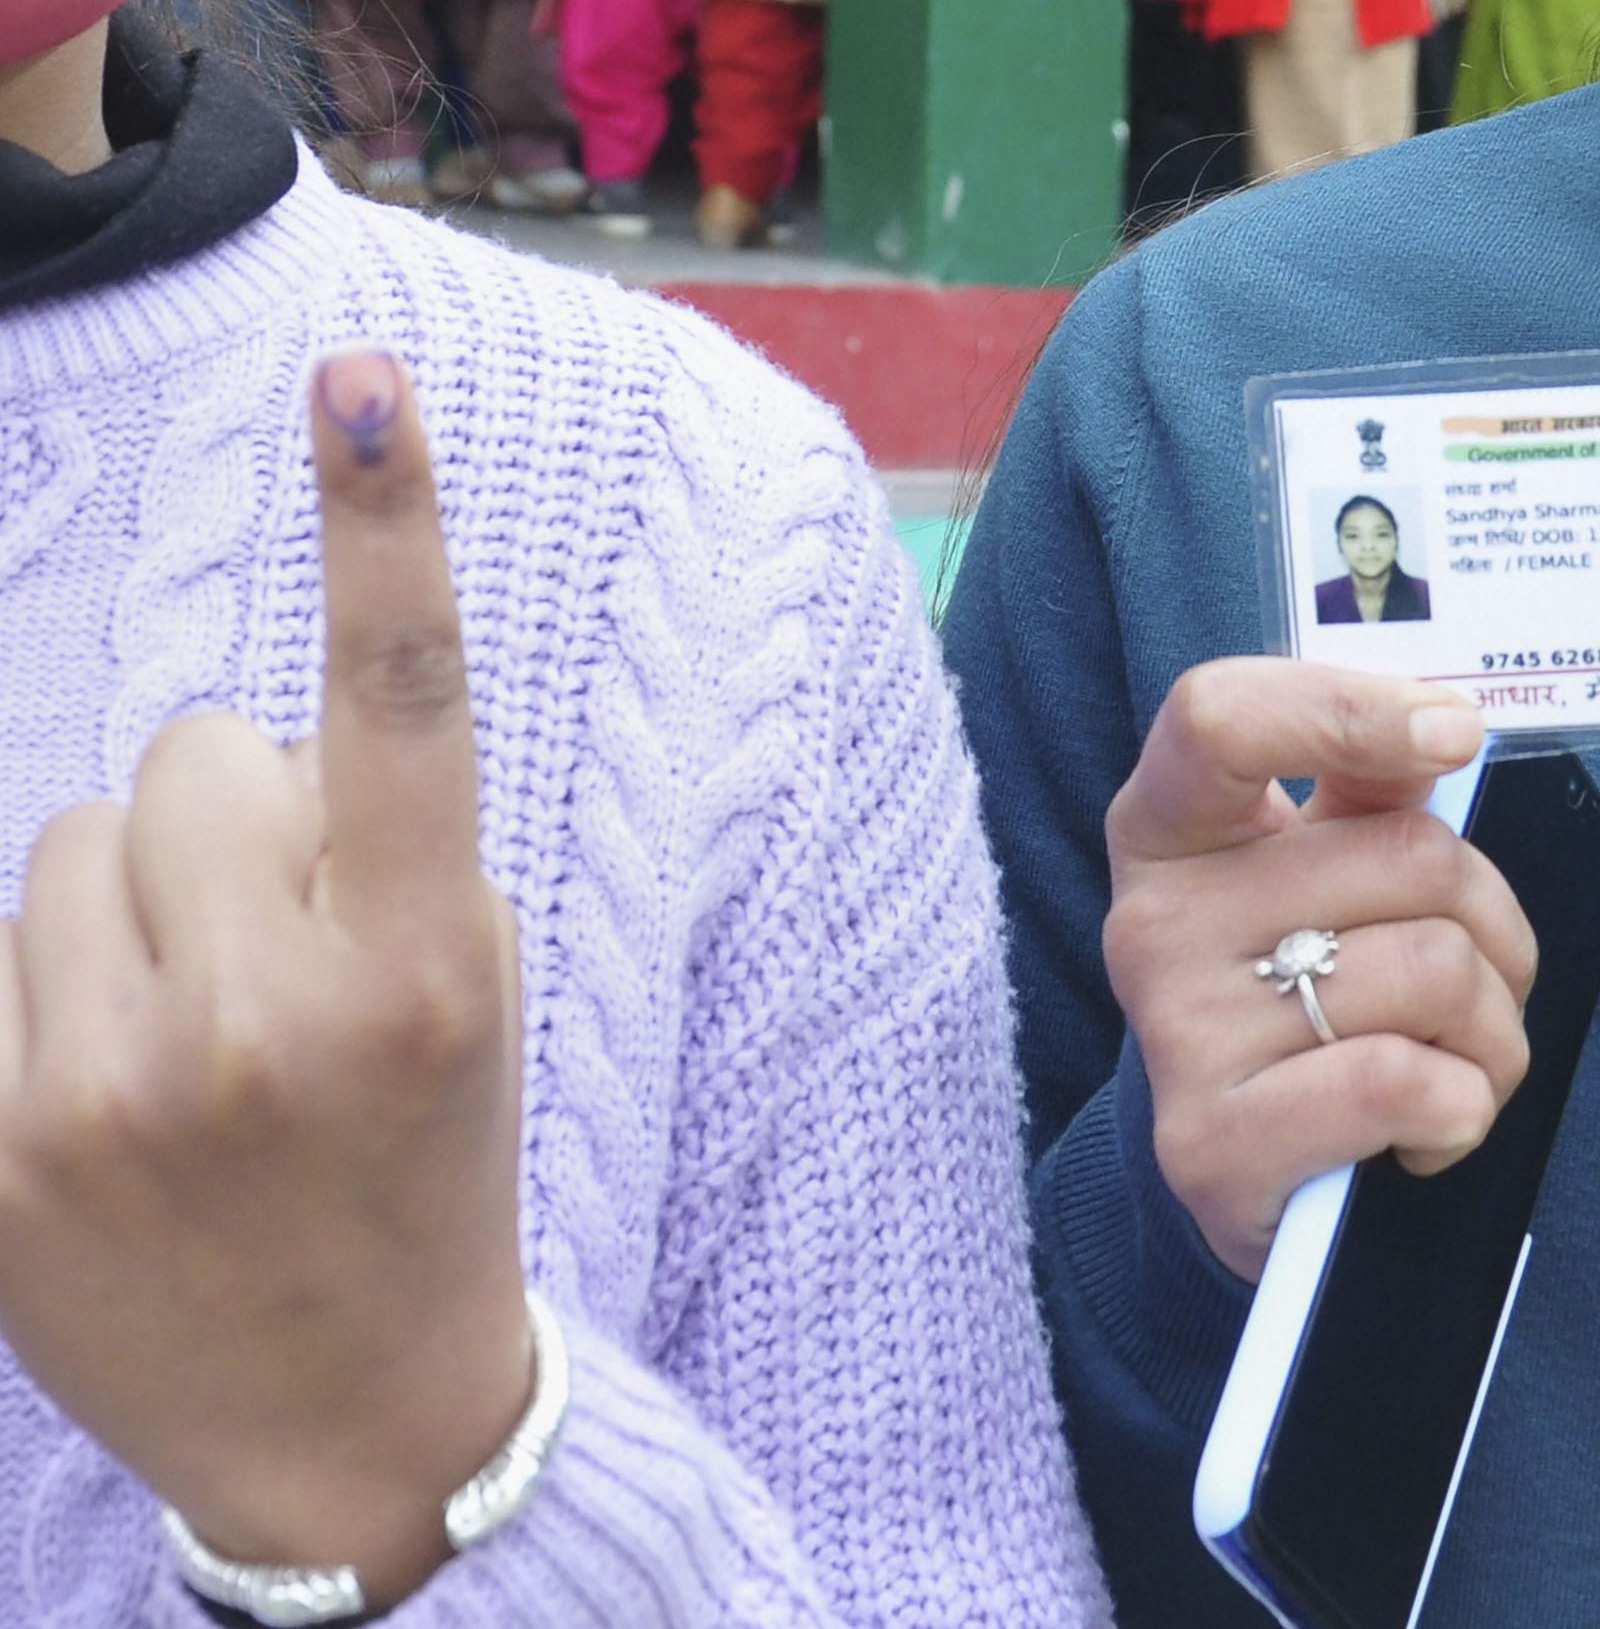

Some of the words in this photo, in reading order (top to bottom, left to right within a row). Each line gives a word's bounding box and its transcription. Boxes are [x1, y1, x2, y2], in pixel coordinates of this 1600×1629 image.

[1467, 444, 1575, 463] Government
[1580, 442, 1599, 458] of
[1445, 505, 1527, 524] Sandhya
[1517, 552, 1593, 570] FEMALE
[1481, 650, 1542, 670] 9745
